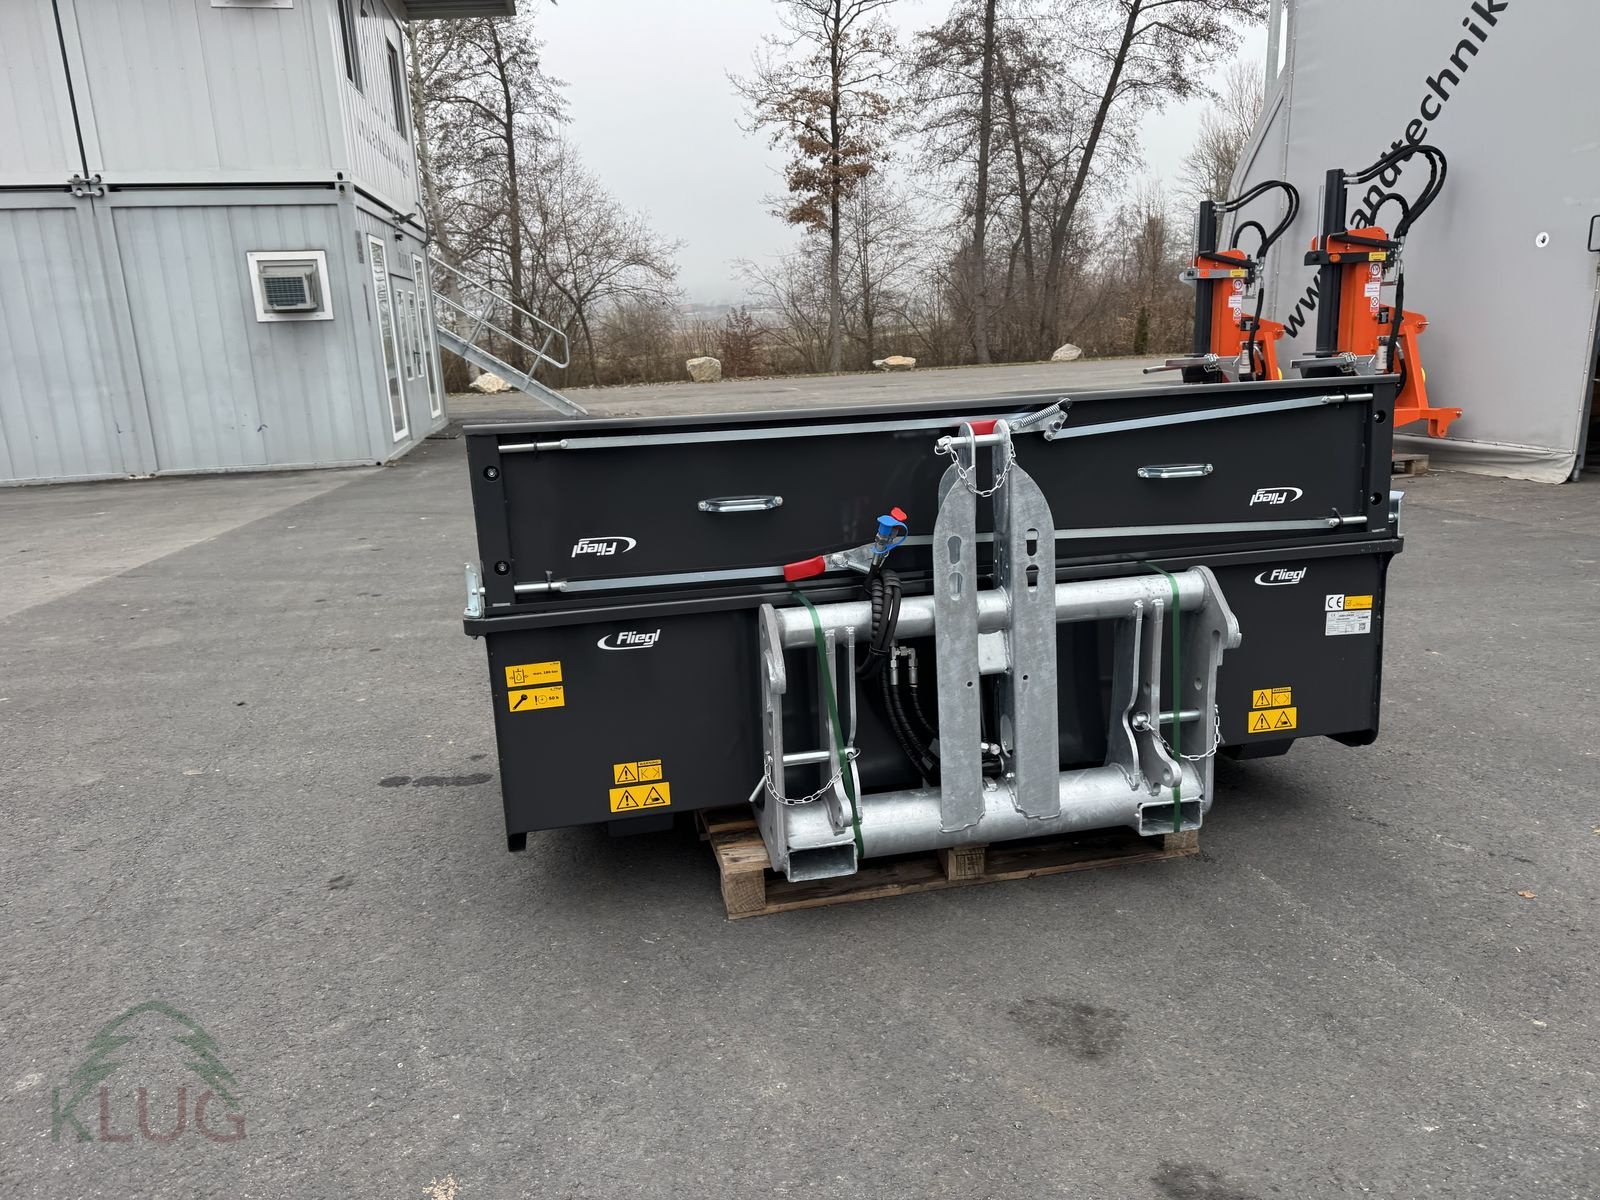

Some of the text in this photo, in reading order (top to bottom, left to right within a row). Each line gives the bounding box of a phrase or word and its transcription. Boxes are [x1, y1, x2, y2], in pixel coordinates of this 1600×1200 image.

[1249, 489, 1288, 506] Fliegl
[571, 540, 617, 558] Fliegl
[1270, 567, 1307, 582] Fliegl
[1327, 596, 1343, 609] CE
[616, 629, 661, 646] Fliegl
